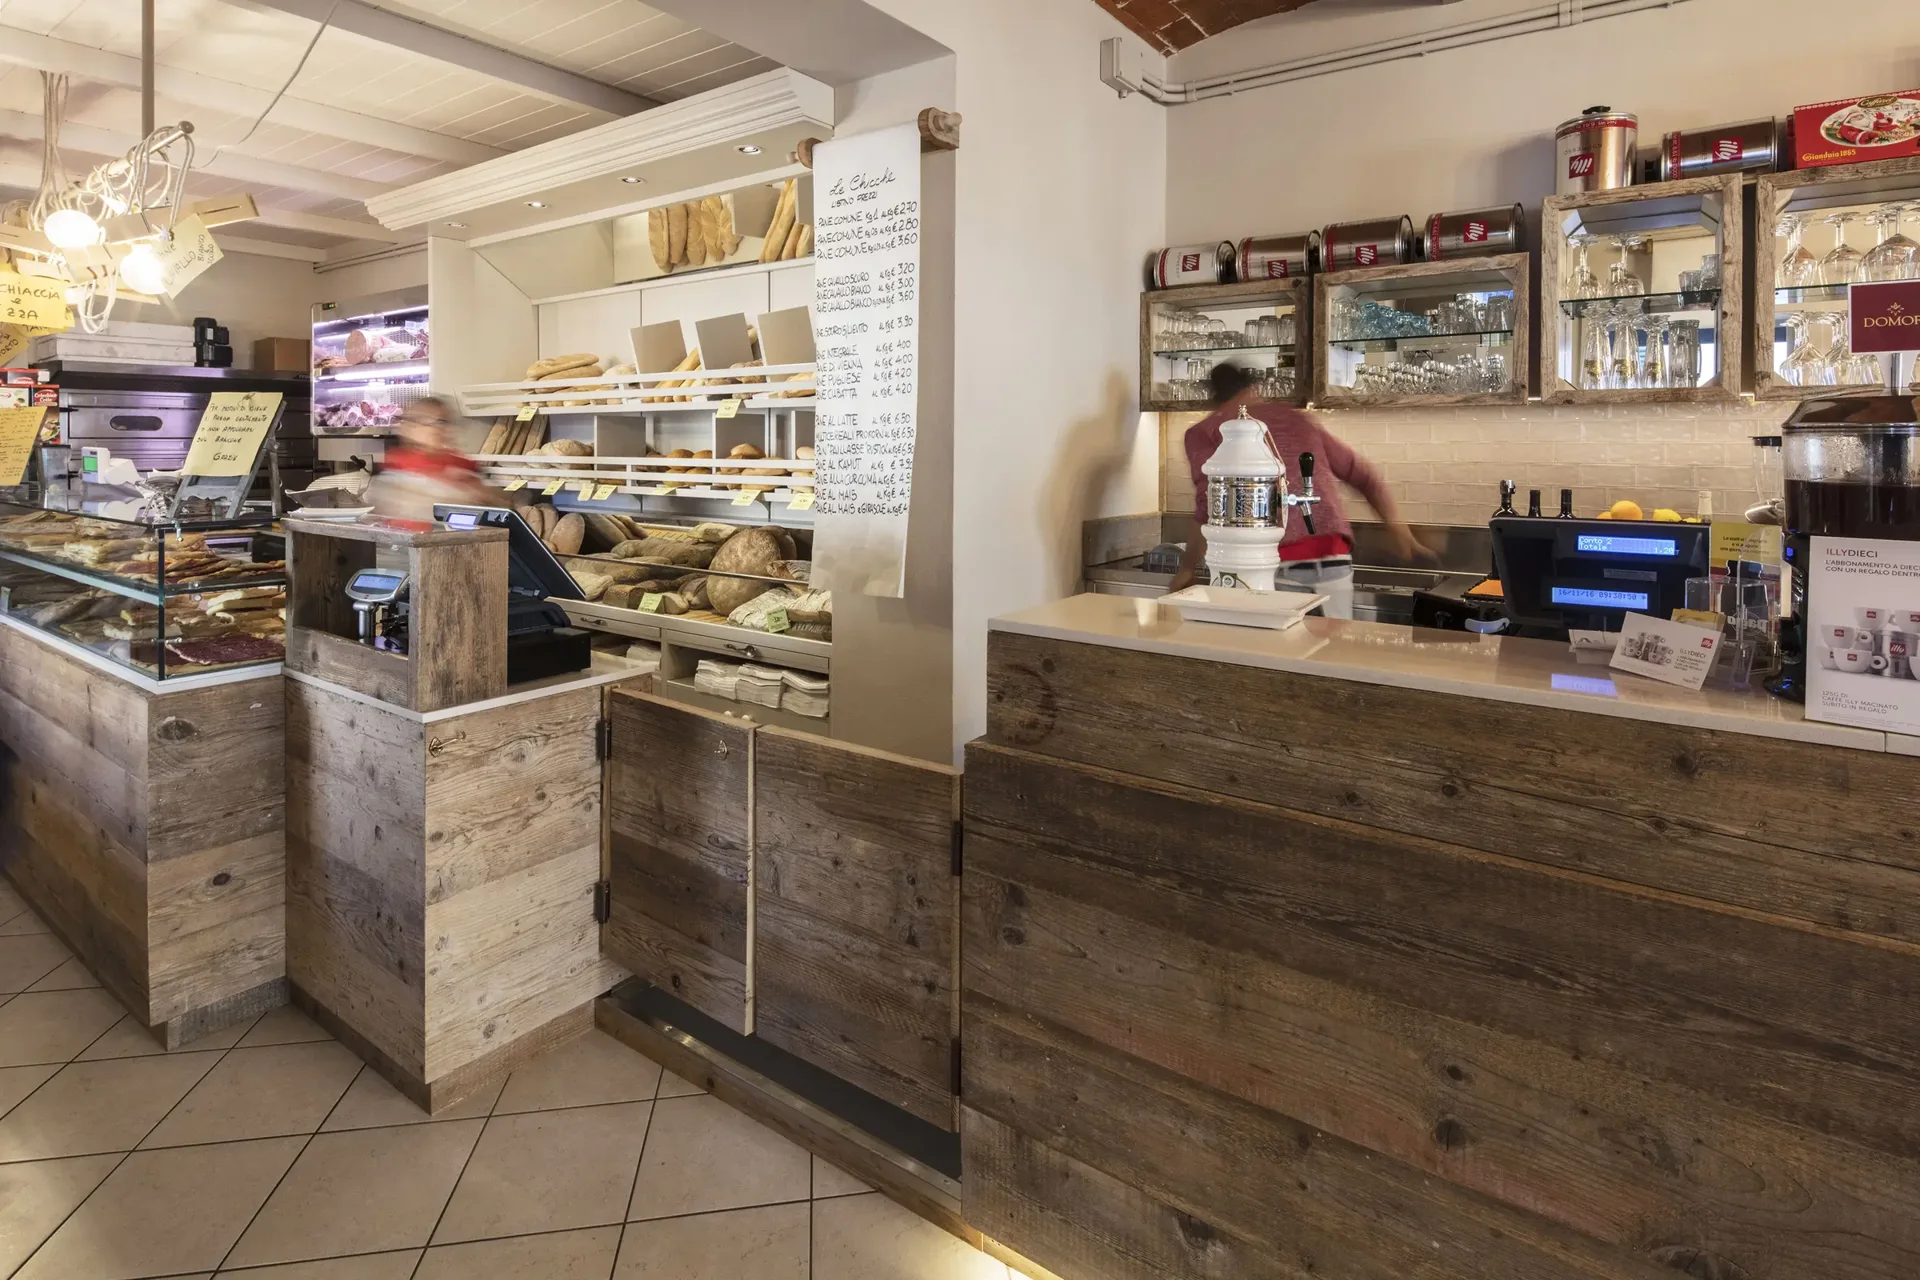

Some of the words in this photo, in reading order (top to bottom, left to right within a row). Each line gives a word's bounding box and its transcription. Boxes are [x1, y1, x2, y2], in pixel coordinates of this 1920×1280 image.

[1715, 140, 1738, 161] illy
[1802, 151, 1840, 161] Gianduia
[1840, 148, 1856, 157] 1865
[1570, 157, 1593, 174] illy
[1466, 222, 1484, 241] illy
[1358, 247, 1374, 265] illy
[1182, 255, 1198, 271] illy
[1271, 261, 1285, 278] illy
[1826, 548, 1878, 558] ILLYDIECI
[1825, 560, 1891, 569] L'ABBONAMENTO
[1859, 568, 1890, 576] REGALO
[1891, 570, 1920, 578] DENTR
[1891, 643, 1906, 654] illy
[1859, 706, 1887, 714] REGALO
[1860, 700, 1899, 710] MACINATO
